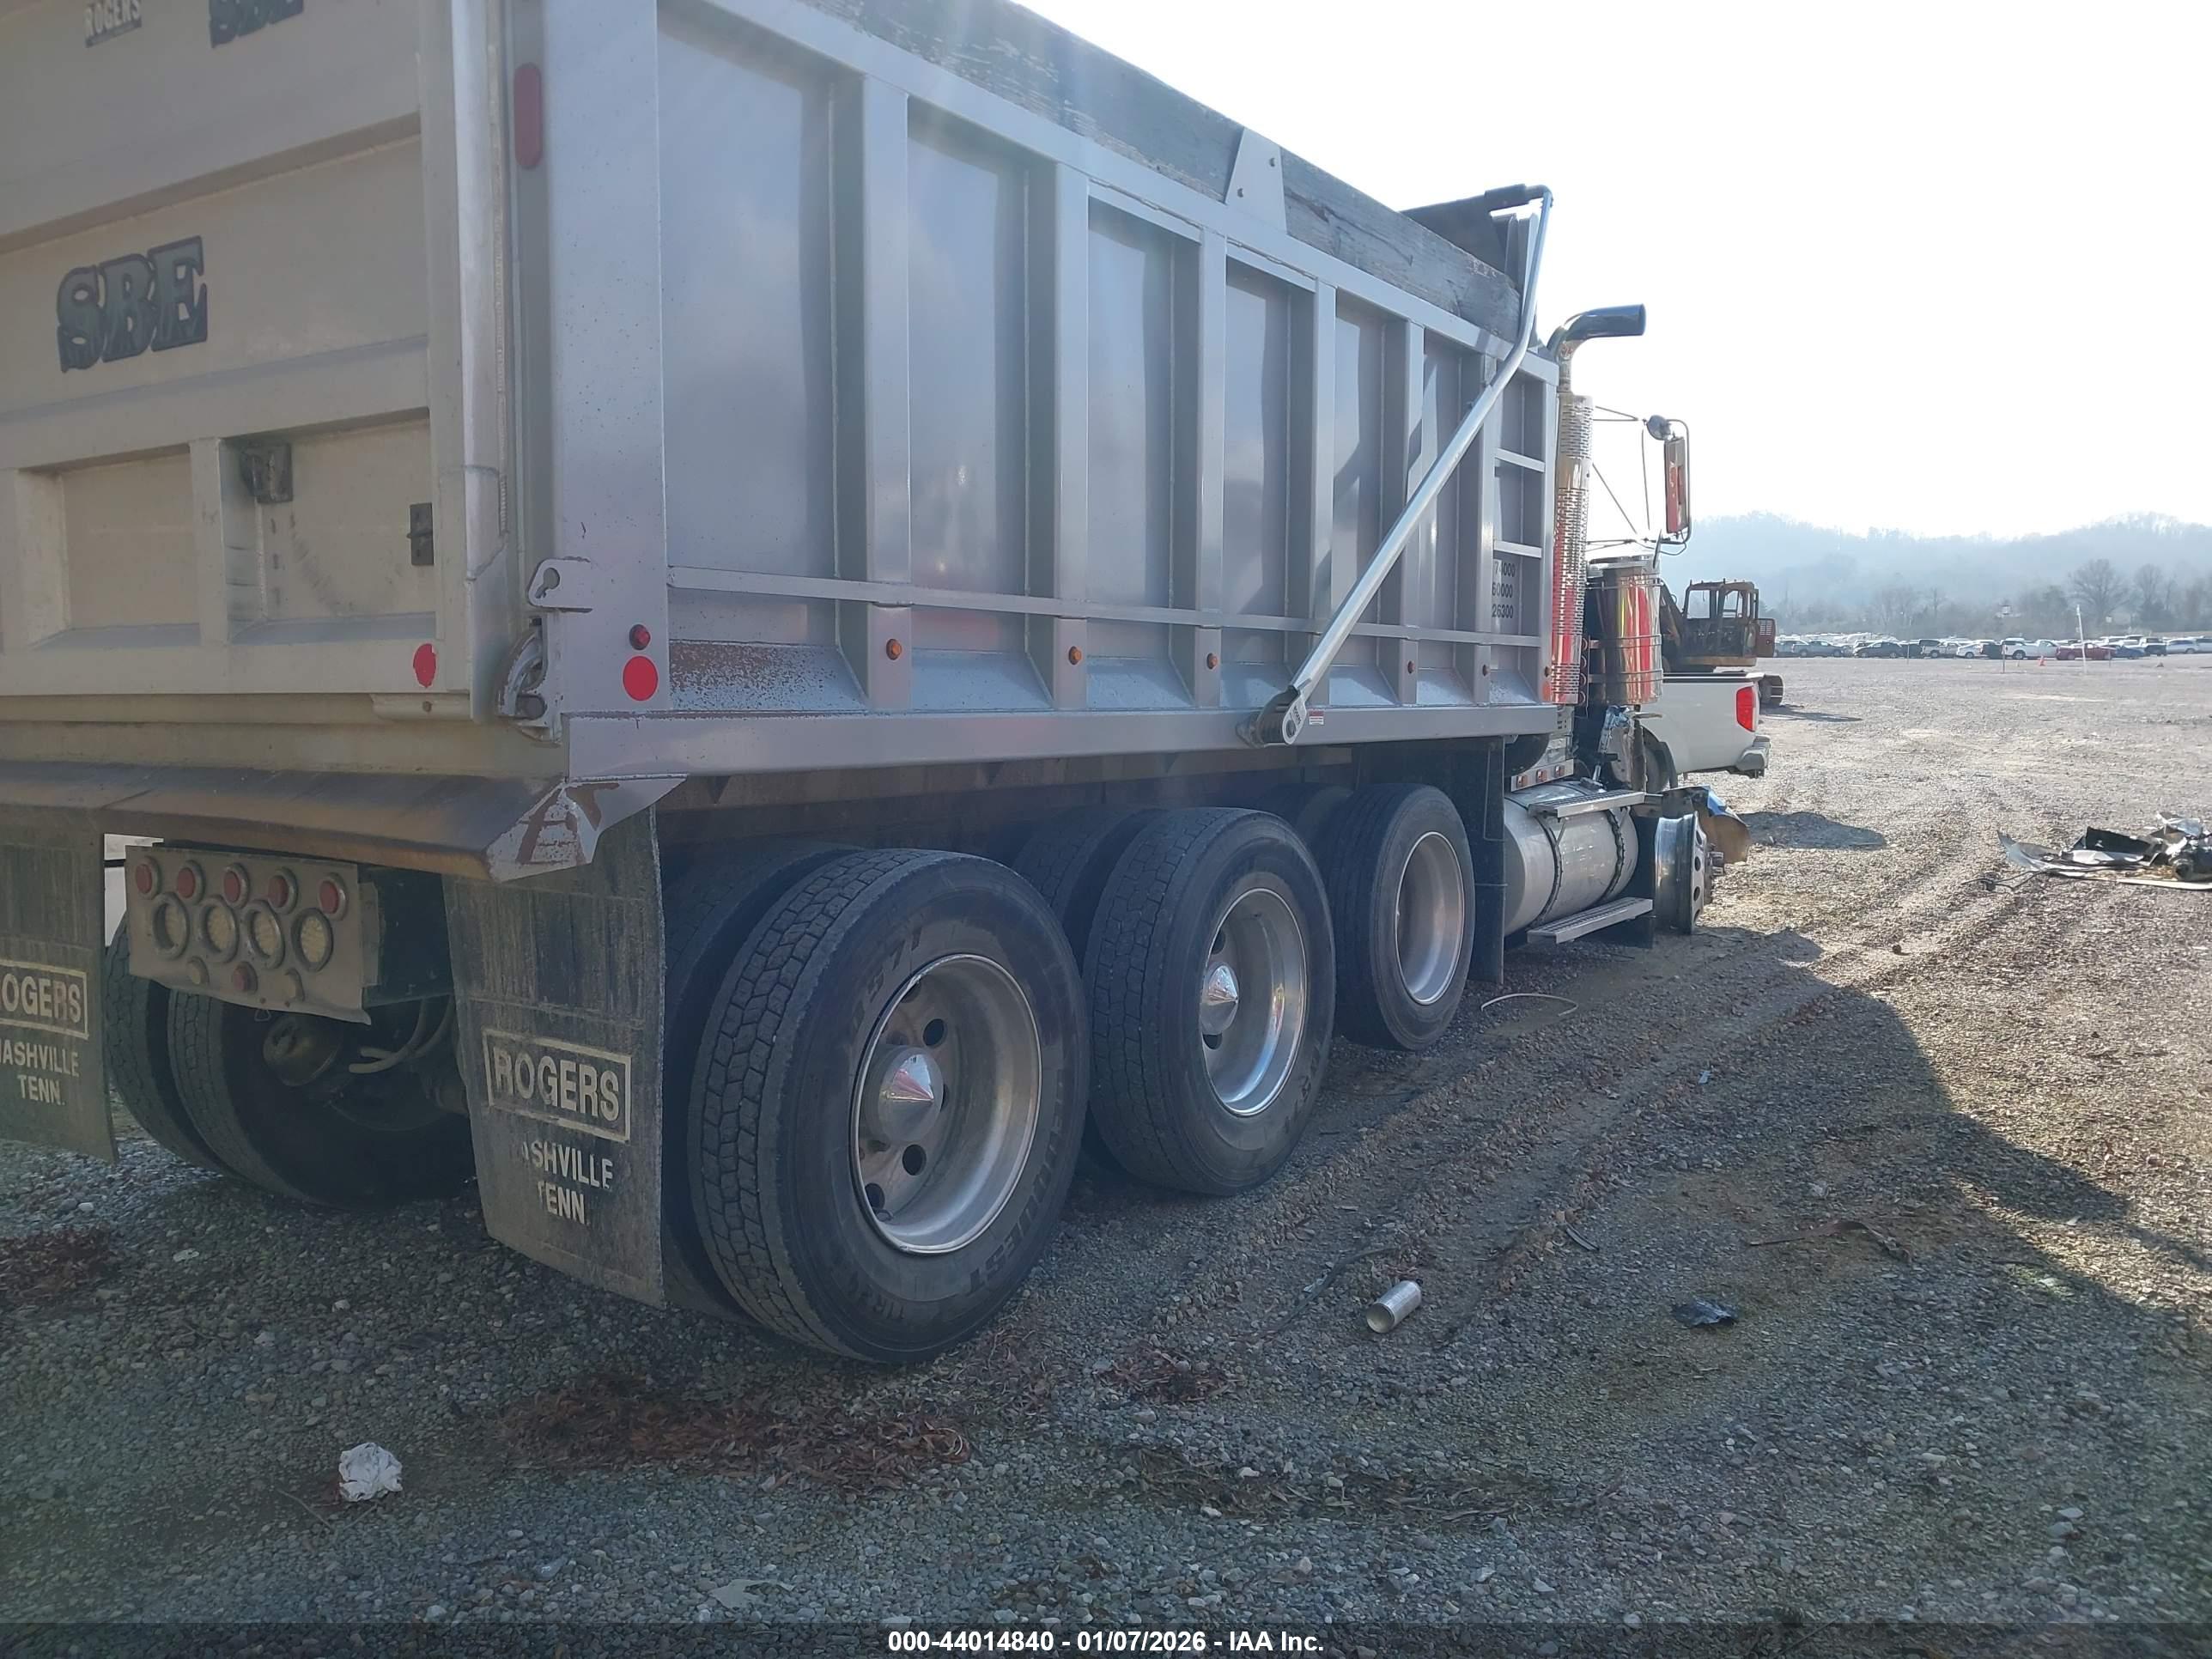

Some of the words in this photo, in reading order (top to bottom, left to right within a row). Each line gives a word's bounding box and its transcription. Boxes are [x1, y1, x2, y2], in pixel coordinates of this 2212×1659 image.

[57, 235, 208, 374] SBE
[0, 971, 82, 1024] OGERS
[493, 1045, 620, 1122] ROGERS
